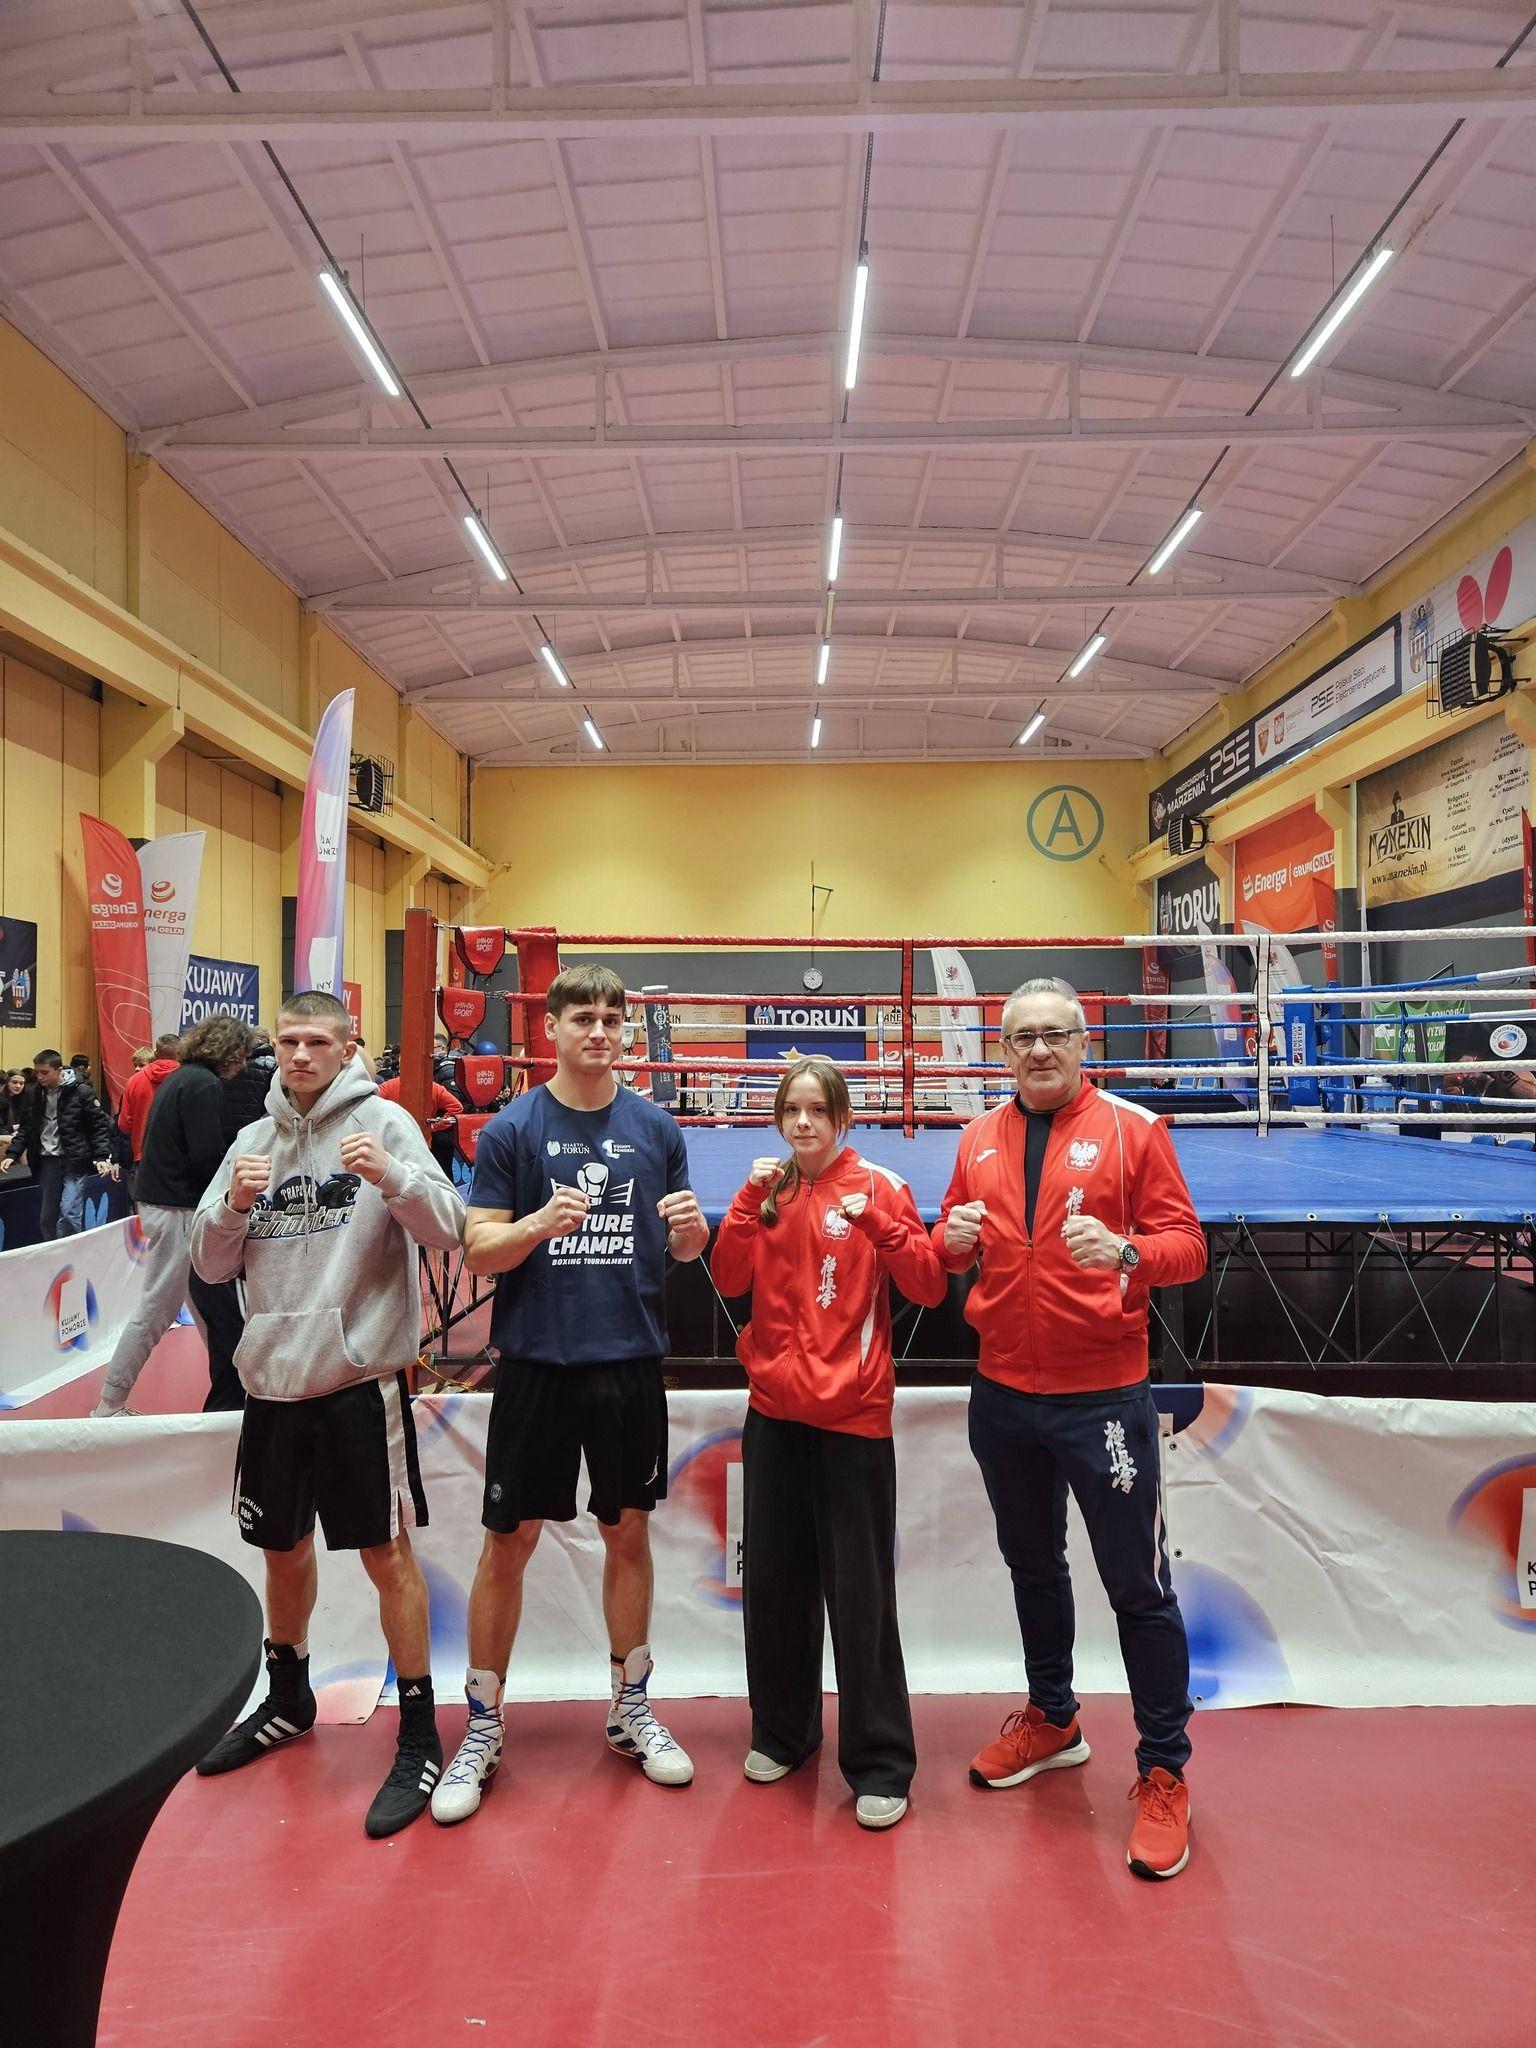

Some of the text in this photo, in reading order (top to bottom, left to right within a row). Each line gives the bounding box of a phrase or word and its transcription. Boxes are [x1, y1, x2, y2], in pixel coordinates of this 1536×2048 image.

[1311, 685, 1335, 714] PSE
[1210, 729, 1250, 784] PSE
[1167, 780, 1207, 815] MARZENIA
[1045, 792, 1085, 847] A
[1368, 815, 1431, 868] MANEKIN
[1255, 867, 1288, 893] Energa
[1314, 853, 1335, 870] ORLE
[144, 908, 187, 924] nerga
[185, 966, 244, 997] KUJAWY
[777, 1005, 859, 1026] TORUŃ
[562, 1145, 590, 1154] TORUŃ
[582, 1214, 635, 1232] TURE
[548, 1236, 635, 1255] CHAMPS
[552, 1258, 582, 1266] BOXING
[61, 1312, 81, 1327] KUJAWY
[61, 1318, 87, 1336] POMORZE
